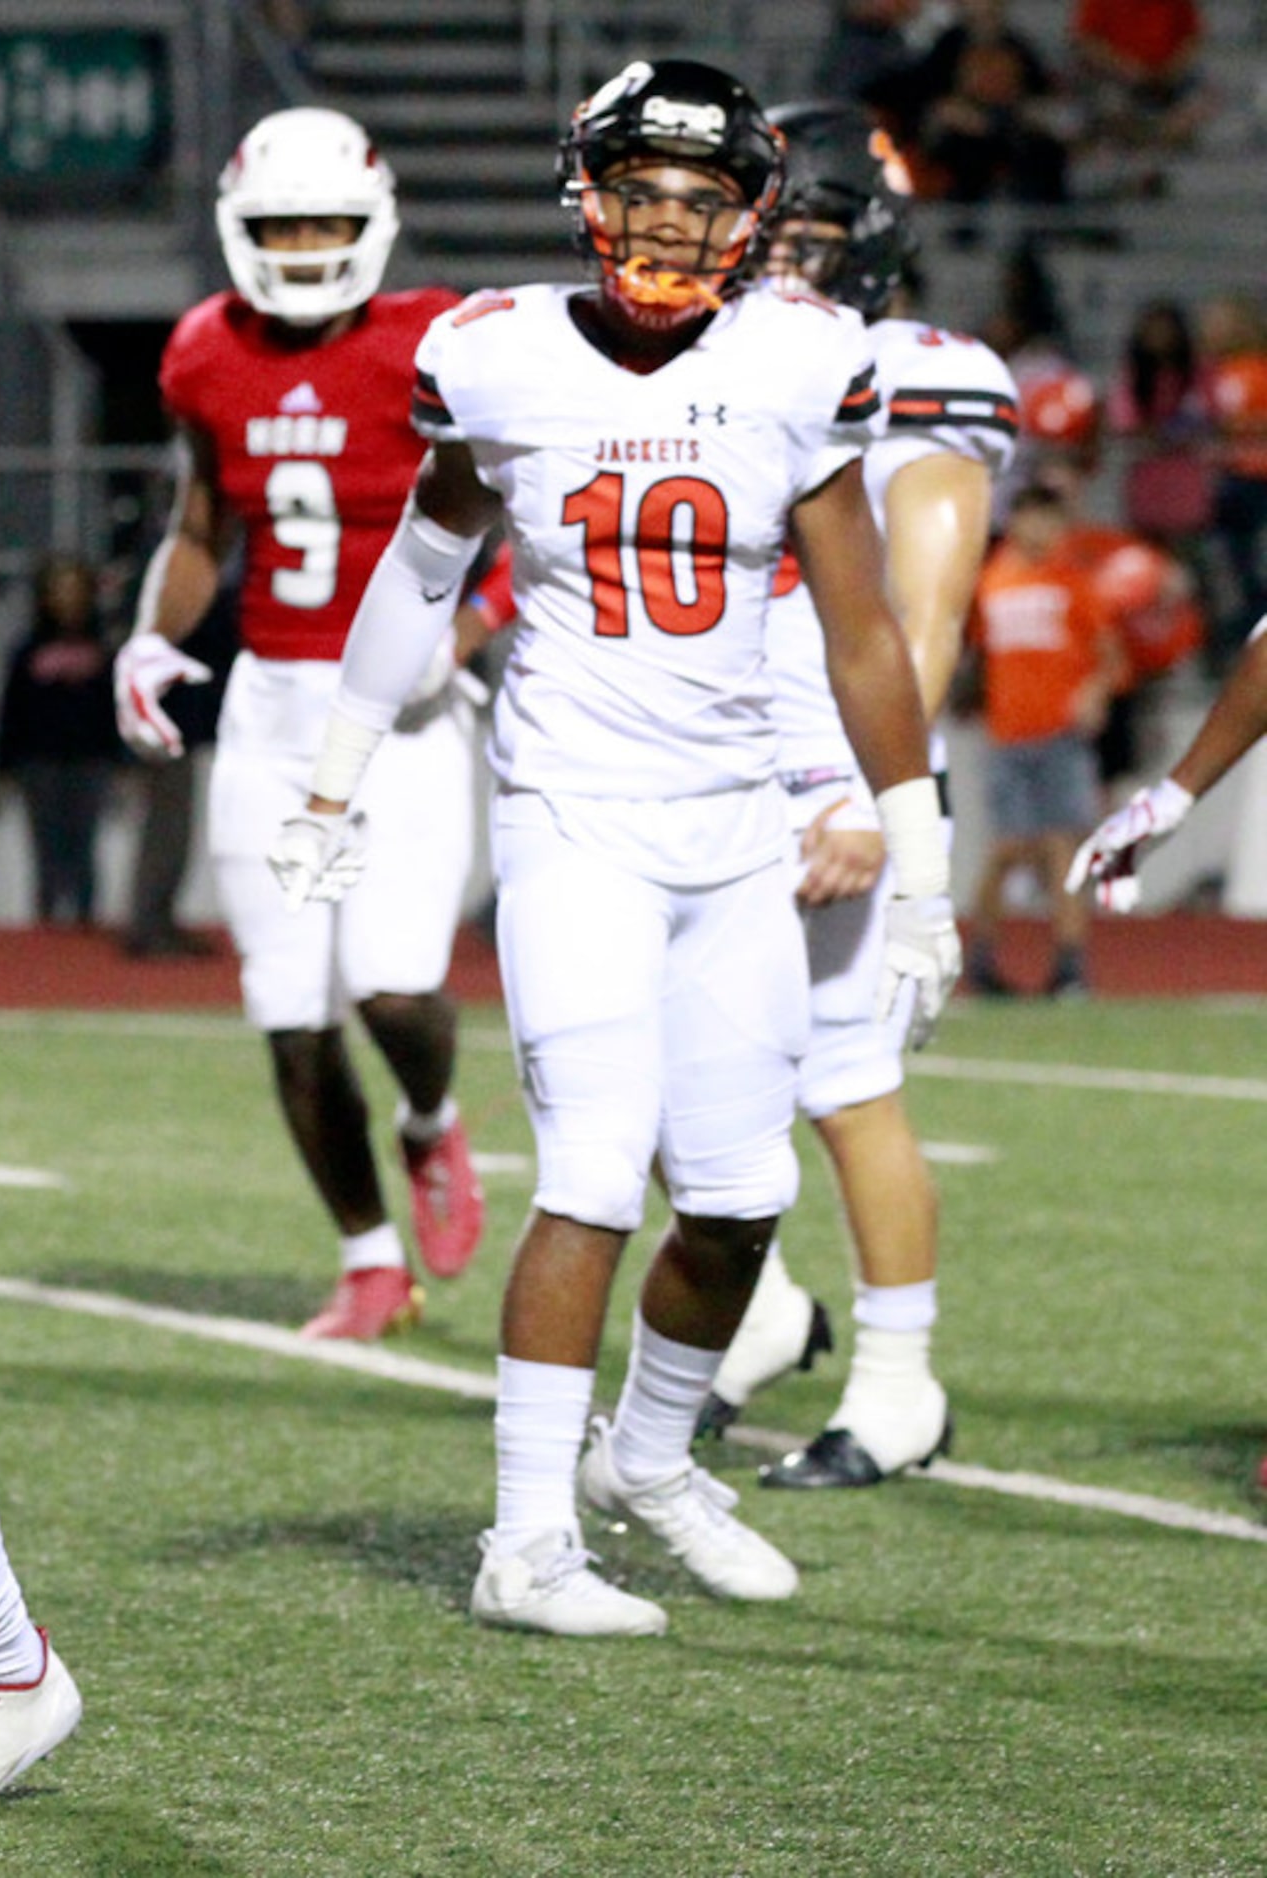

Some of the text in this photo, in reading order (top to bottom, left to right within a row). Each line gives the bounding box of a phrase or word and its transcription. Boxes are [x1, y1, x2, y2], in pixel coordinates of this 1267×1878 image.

[246, 415, 348, 456] HORN
[594, 439, 701, 463] JACKETS
[264, 460, 341, 609] 9
[561, 470, 729, 639] 10
